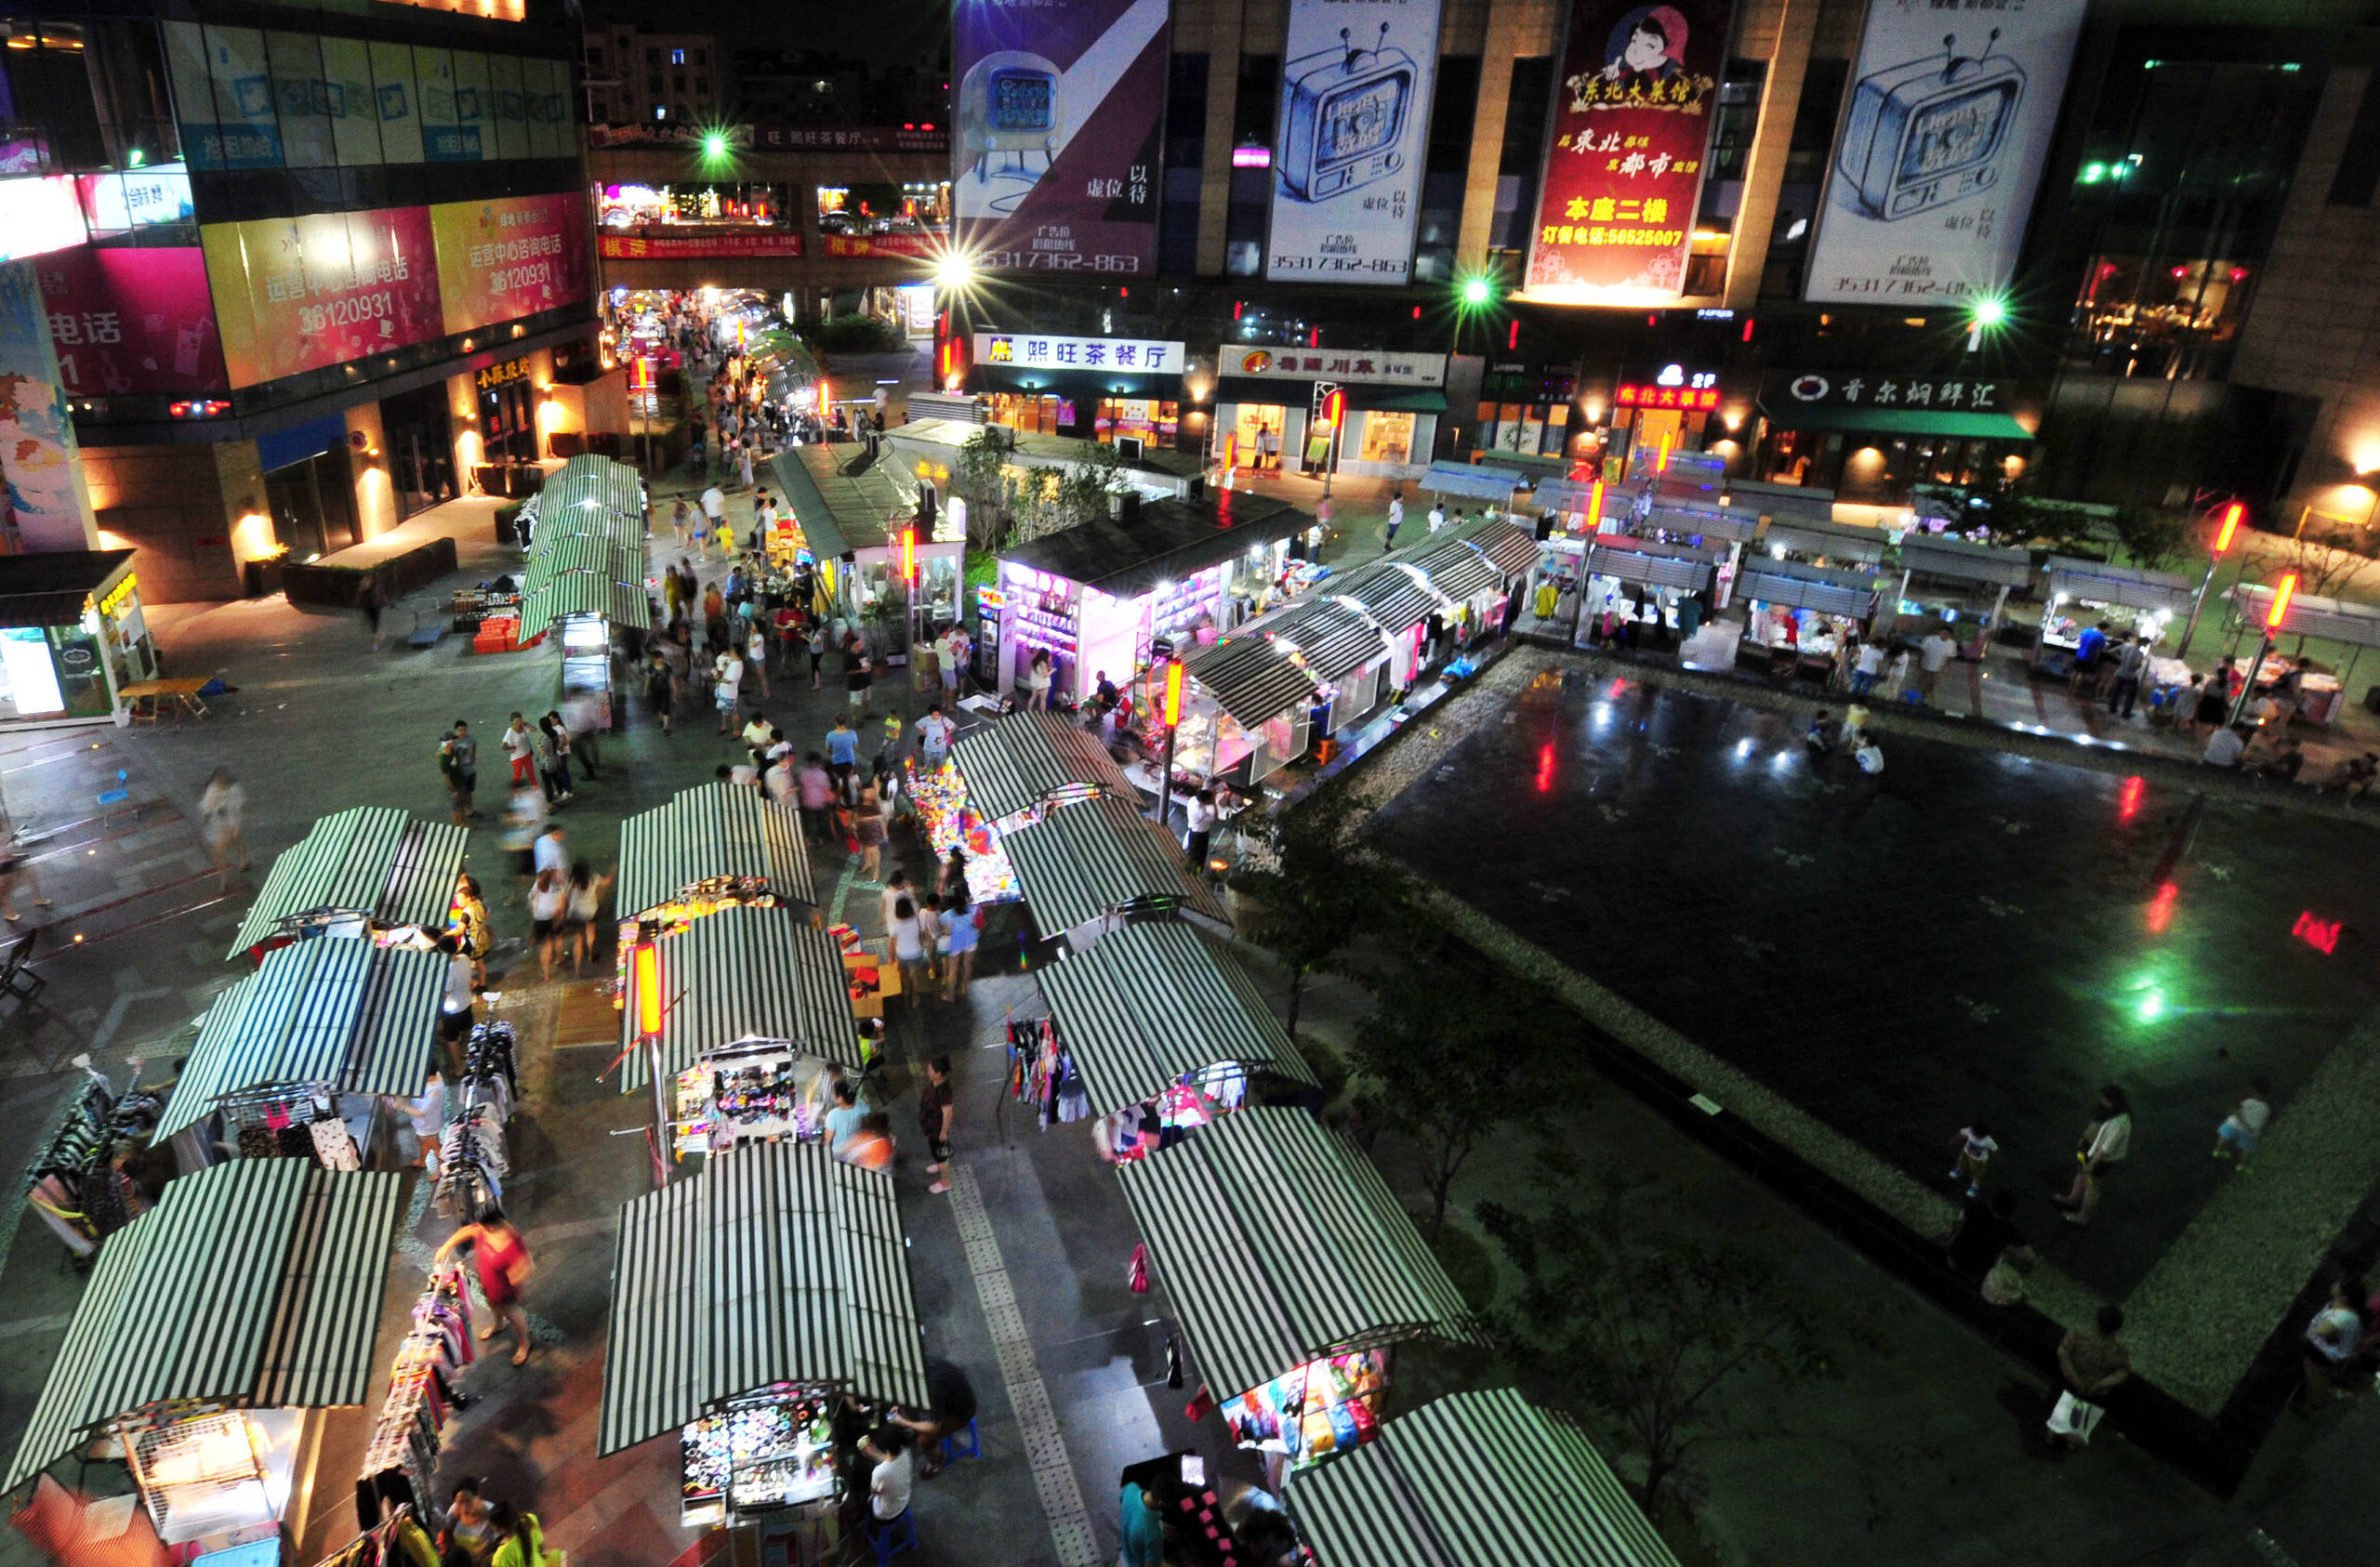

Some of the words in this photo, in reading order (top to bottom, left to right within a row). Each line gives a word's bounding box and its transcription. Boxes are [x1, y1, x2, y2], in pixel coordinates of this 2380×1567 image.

[1583, 79, 1691, 102] 东北大菜馆
[1565, 195, 1669, 224] 本座二楼
[1542, 225, 1684, 247] 订餐电话:56525007
[469, 233, 562, 269] 运营中心咨询电话
[298, 291, 392, 333] 36120931
[1026, 340, 1168, 369] 熙旺茶餐厅
[1691, 373, 1717, 388] 2F
